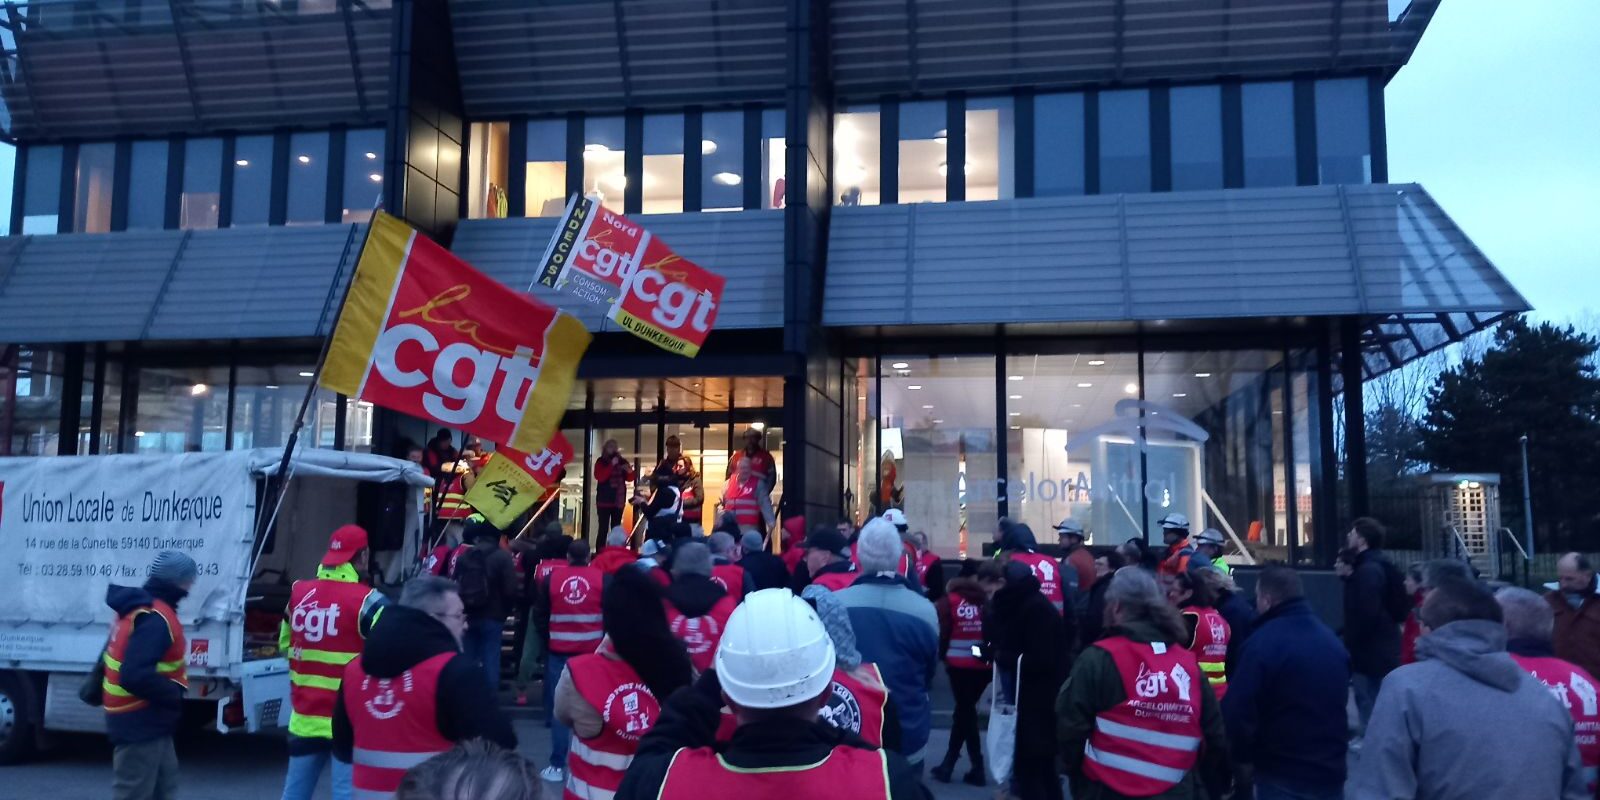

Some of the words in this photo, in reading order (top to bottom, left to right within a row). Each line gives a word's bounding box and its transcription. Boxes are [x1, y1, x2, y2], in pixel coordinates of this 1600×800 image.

[602, 213, 638, 238] Nord
[542, 198, 588, 287] INDECOSA
[578, 239, 633, 278] cgt
[643, 254, 690, 283] la
[572, 289, 601, 305] ACTION
[632, 268, 715, 333] cgt
[622, 315, 634, 328] UL
[634, 321, 687, 350] DUNKERQUE
[374, 323, 545, 424] cgt
[525, 448, 563, 476] gt
[22, 492, 64, 523] Union
[67, 491, 115, 522] Locale
[121, 501, 135, 522] de
[142, 490, 223, 528] Dunkerque
[25, 538, 37, 548] 14
[40, 541, 55, 549] rue
[57, 538, 70, 549] de
[71, 538, 80, 549] la
[82, 537, 118, 549] Cunette
[121, 537, 151, 549] 59140
[153, 537, 204, 551] Dunkerque
[121, 564, 136, 576] fax
[294, 588, 318, 610] la
[291, 603, 340, 642] cgt
[1135, 662, 1150, 681] la
[1135, 671, 1168, 698] cgt
[603, 693, 616, 722] GRAND
[614, 682, 634, 695] PORT
